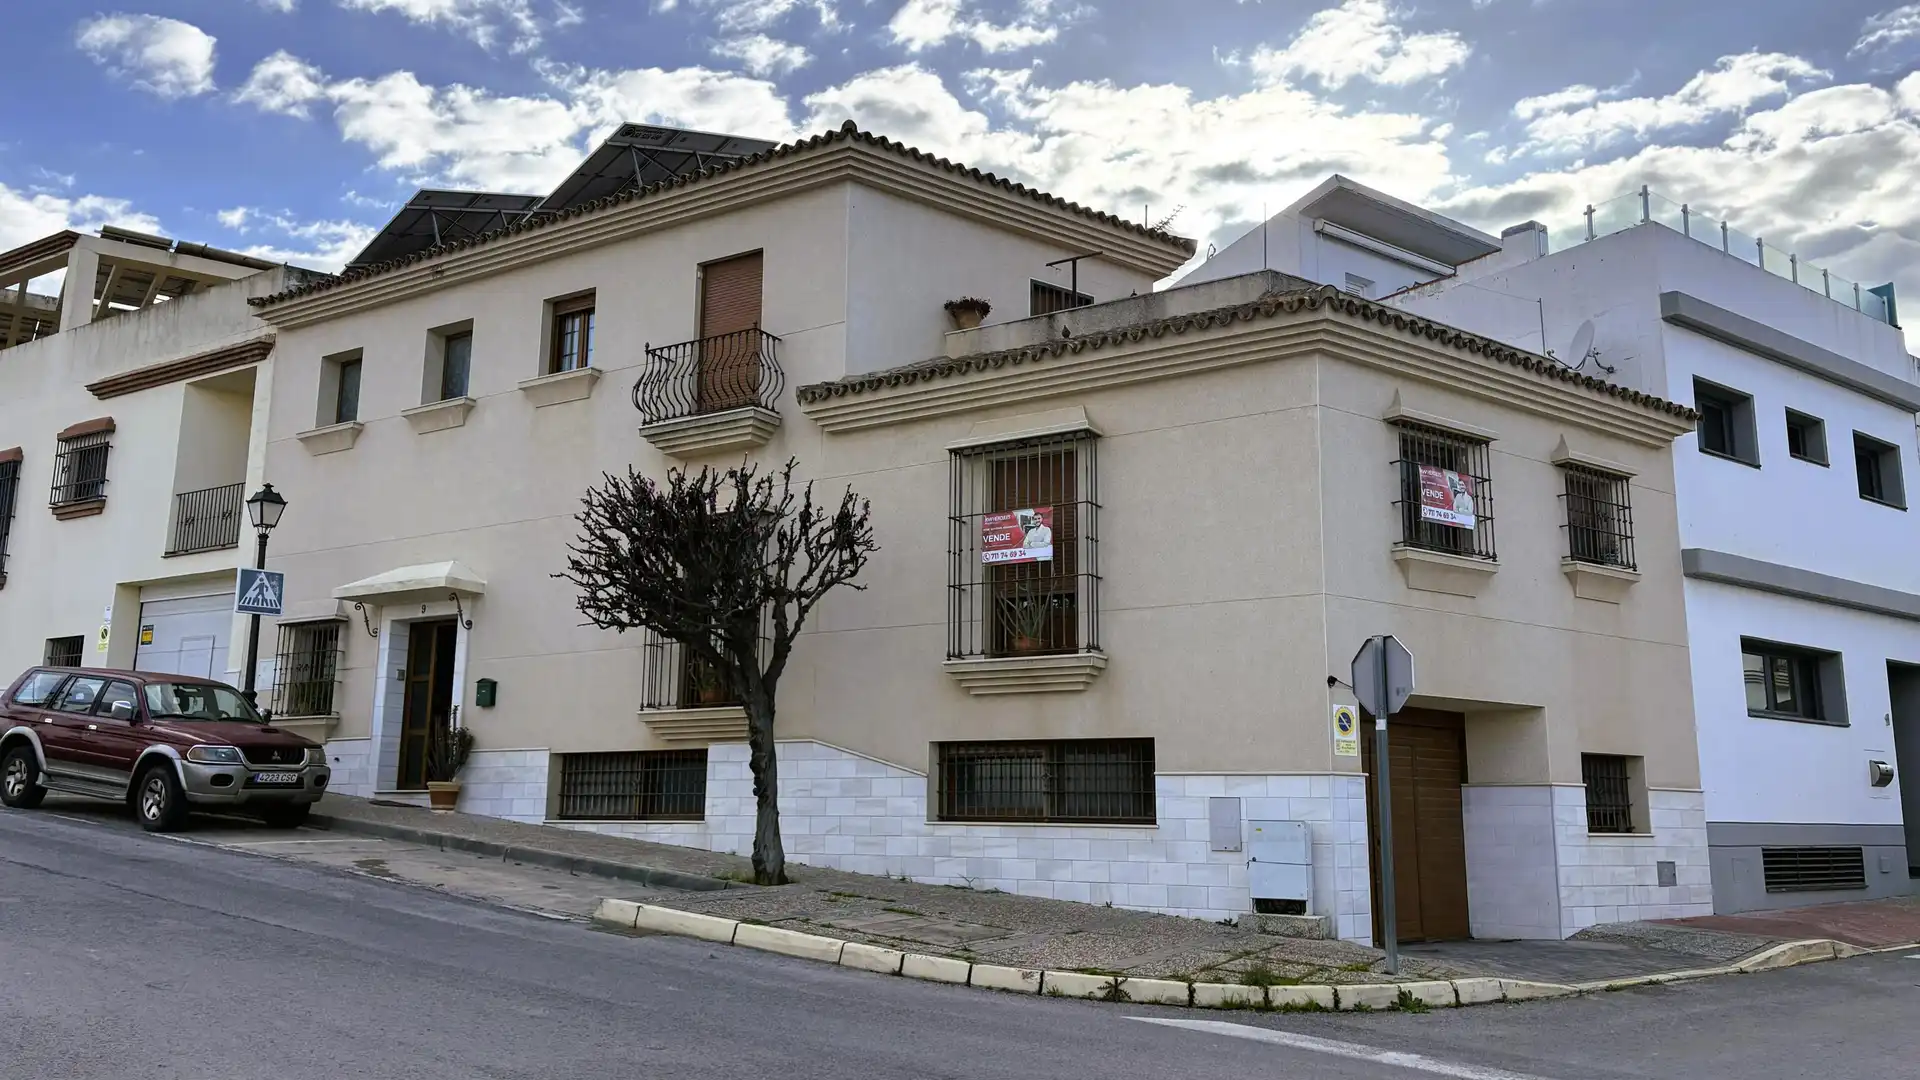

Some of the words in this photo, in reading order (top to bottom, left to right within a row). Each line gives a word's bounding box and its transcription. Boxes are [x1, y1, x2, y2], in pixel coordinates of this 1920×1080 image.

[1421, 488, 1444, 500] VENDE
[983, 532, 1011, 543] VENDE
[991, 552, 1000, 560] 711
[421, 604, 426, 614] 9
[259, 773, 280, 782] 4223
[281, 773, 297, 782] CSC
